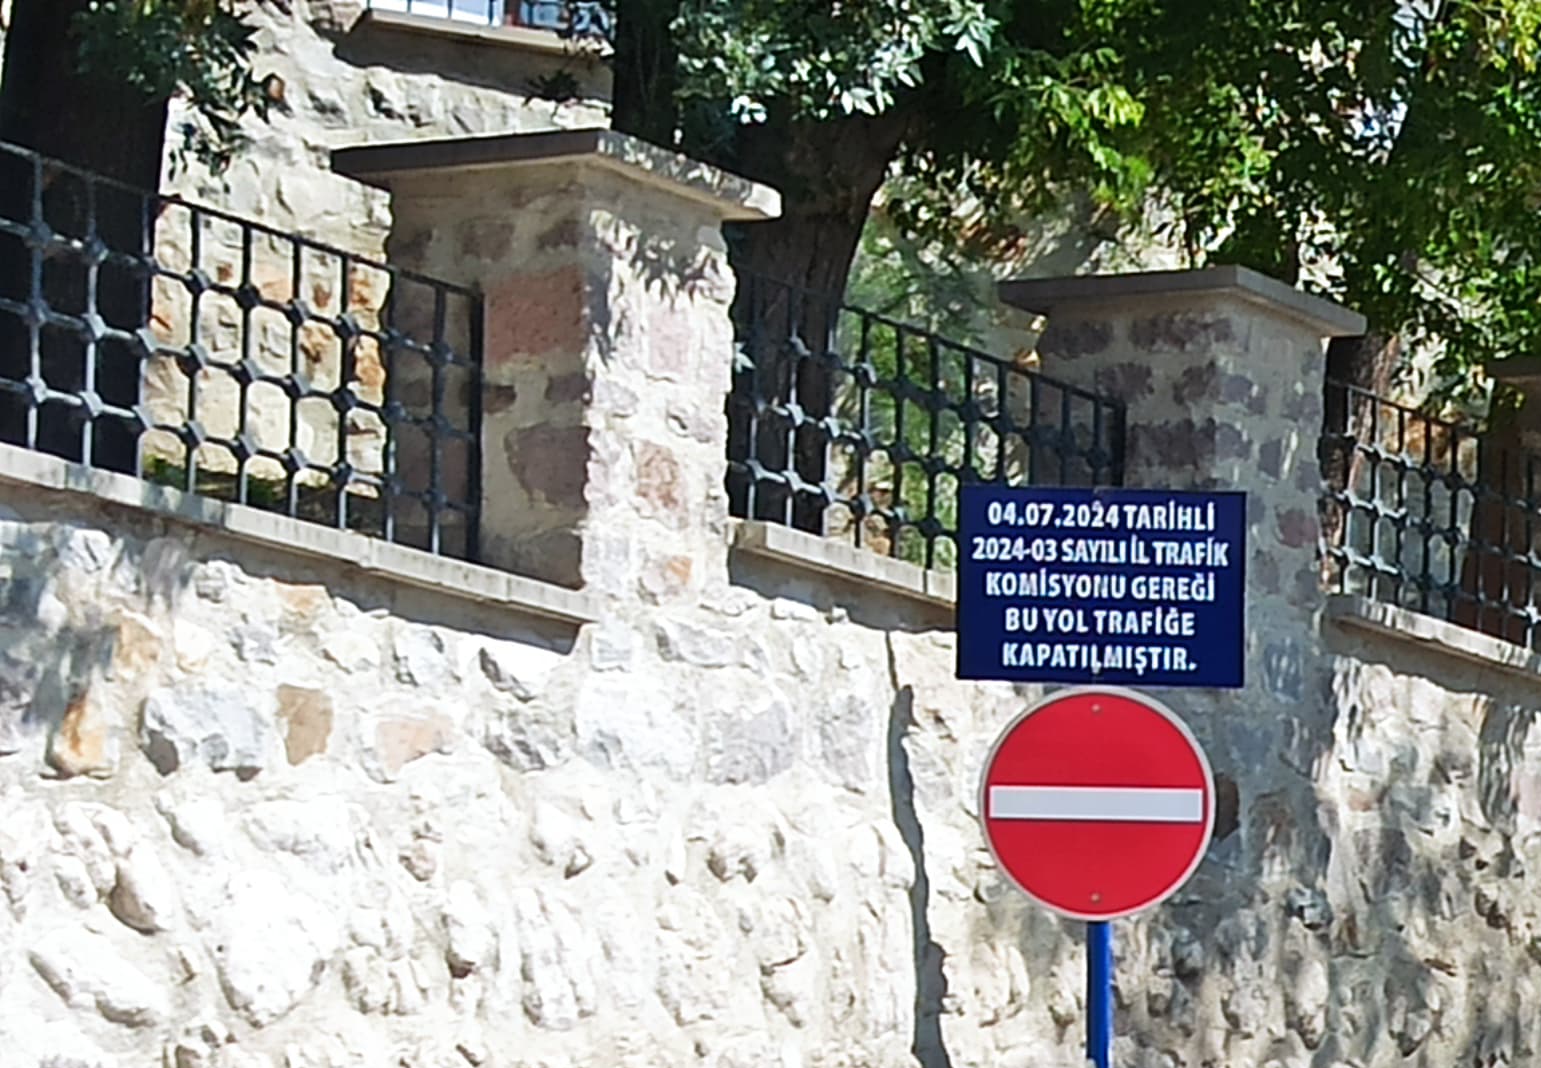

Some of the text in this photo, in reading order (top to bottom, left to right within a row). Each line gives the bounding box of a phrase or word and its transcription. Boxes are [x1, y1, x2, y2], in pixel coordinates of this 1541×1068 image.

[987, 500, 1216, 532] 04.07.2024 TARİHLİ
[971, 534, 1229, 567] 2024-03 SAYILI İL TRAFİK
[985, 567, 1216, 602] KOMİSYONU GEREĞİ
[1005, 606, 1196, 636] BU YOL TRAFİĞE
[1001, 642, 1198, 676] KAPATILMIŞTIR.
